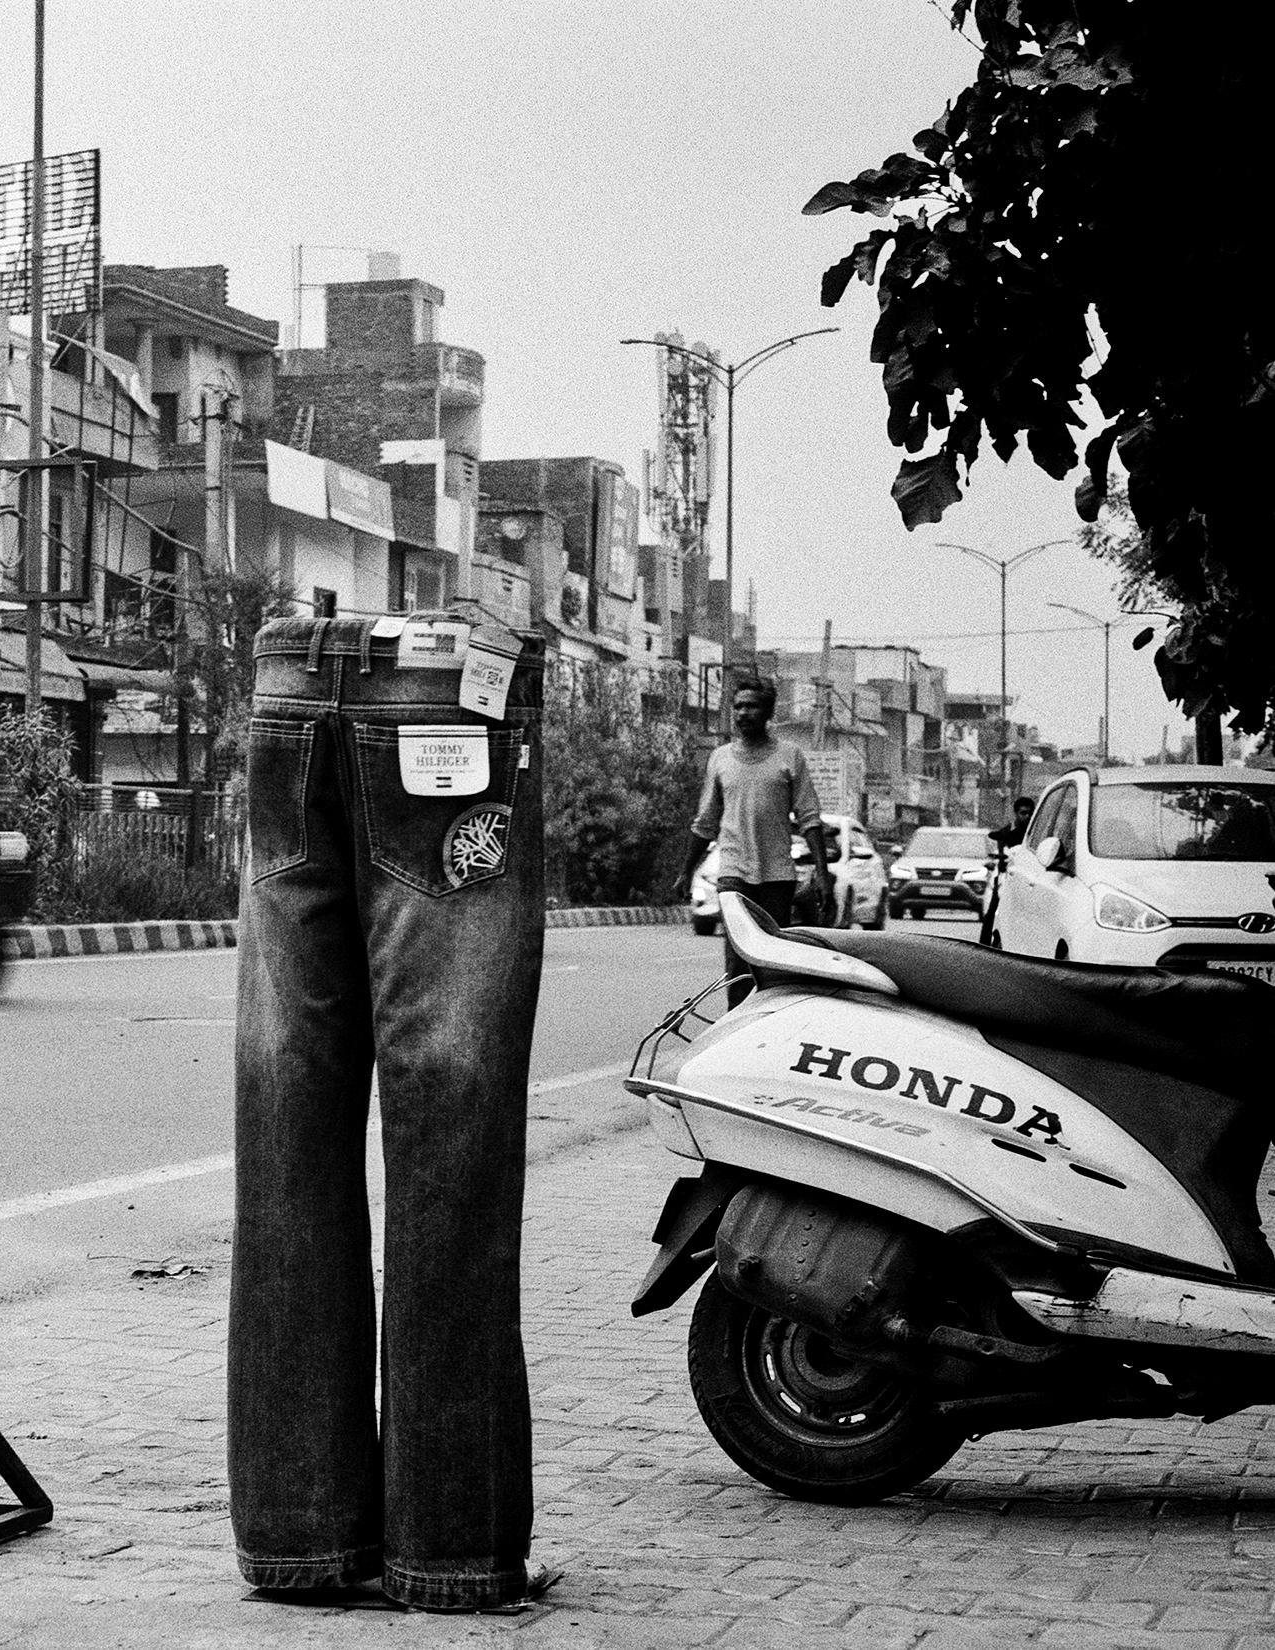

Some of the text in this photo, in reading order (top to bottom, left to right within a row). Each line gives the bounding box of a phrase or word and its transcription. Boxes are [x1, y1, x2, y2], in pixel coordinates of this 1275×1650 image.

[416, 756, 470, 767] HILFIGER
[421, 744, 465, 755] TOMMY
[790, 1042, 1067, 1145] HONDA
[772, 1096, 931, 1137] Activa
